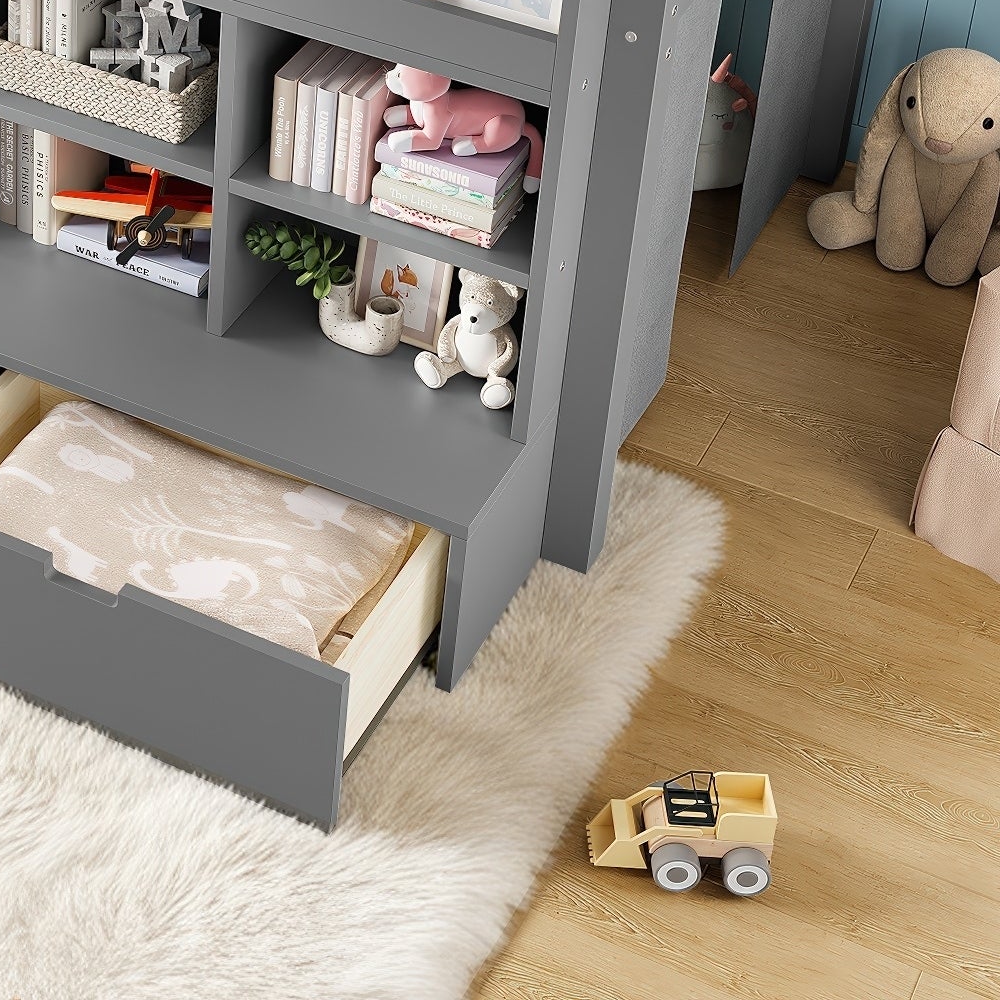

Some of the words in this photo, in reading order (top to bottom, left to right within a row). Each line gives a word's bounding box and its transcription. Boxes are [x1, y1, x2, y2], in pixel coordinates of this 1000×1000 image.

[6, 134, 14, 162] SECRET
[22, 133, 30, 163] BASIC
[315, 110, 329, 177] UNICORNS
[6, 165, 14, 193] GARDEN
[400, 156, 470, 188] DINOSAURS
[389, 187, 408, 201] The
[410, 194, 438, 211] Little
[440, 204, 474, 222] Prince
[74, 245, 100, 260] WAR
